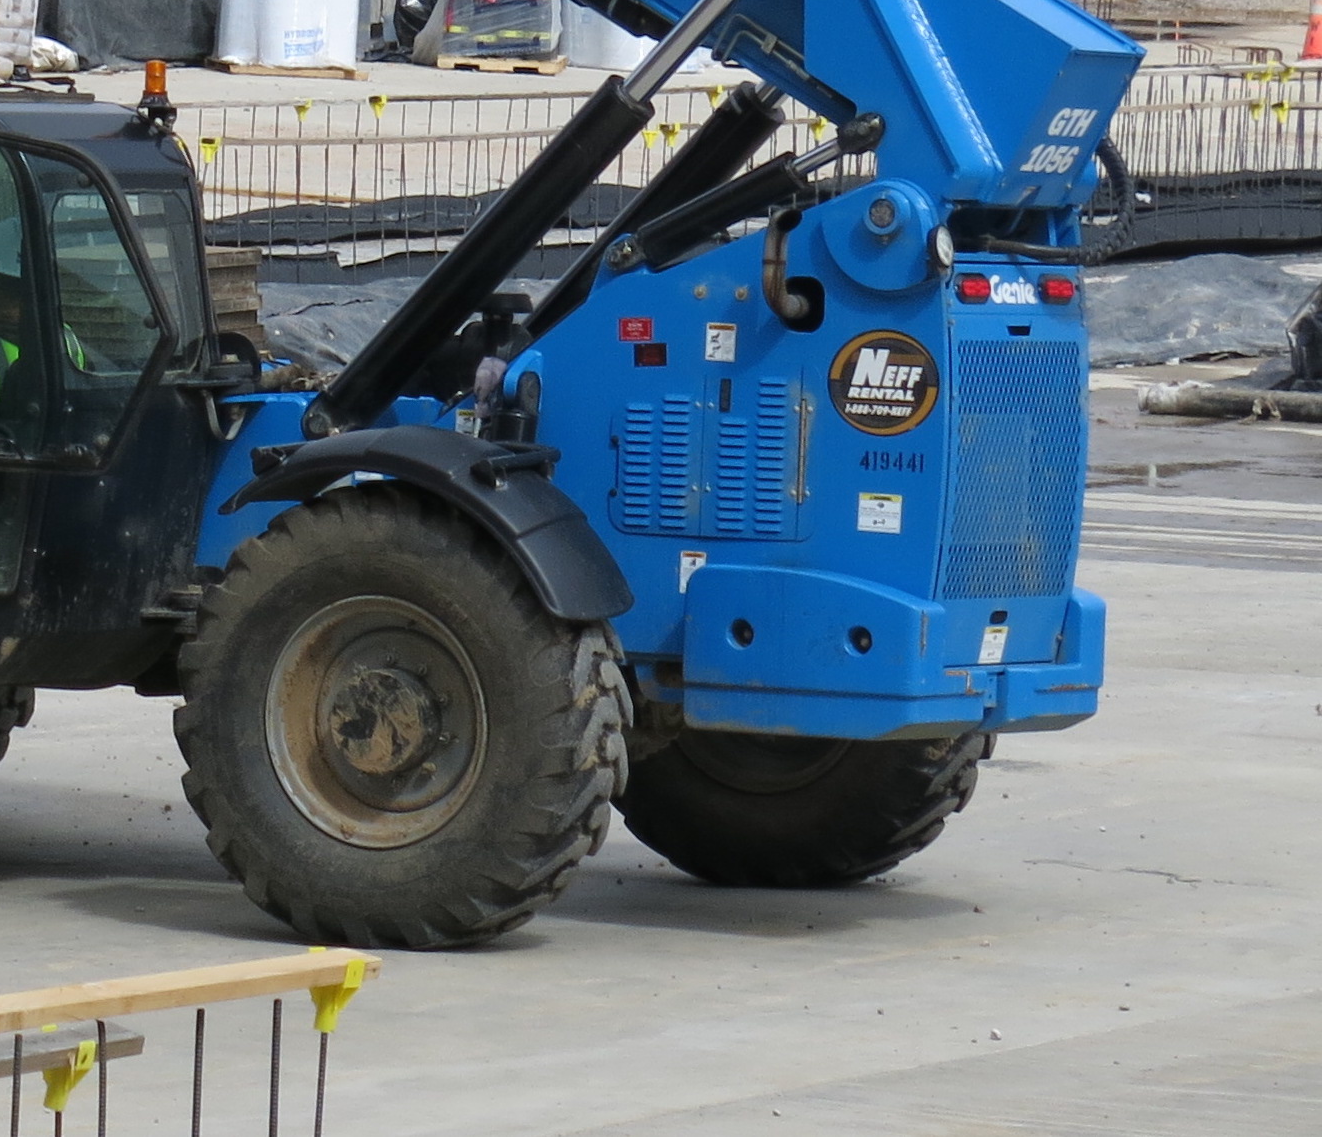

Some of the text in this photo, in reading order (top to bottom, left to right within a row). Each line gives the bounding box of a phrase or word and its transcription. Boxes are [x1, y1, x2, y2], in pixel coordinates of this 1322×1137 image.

[1048, 107, 1098, 137] GTH
[1020, 144, 1080, 174] 1056
[990, 274, 1038, 305] Genie
[851, 347, 923, 388] NEFF
[848, 386, 915, 402] RENTAL
[859, 450, 925, 473] 419441
